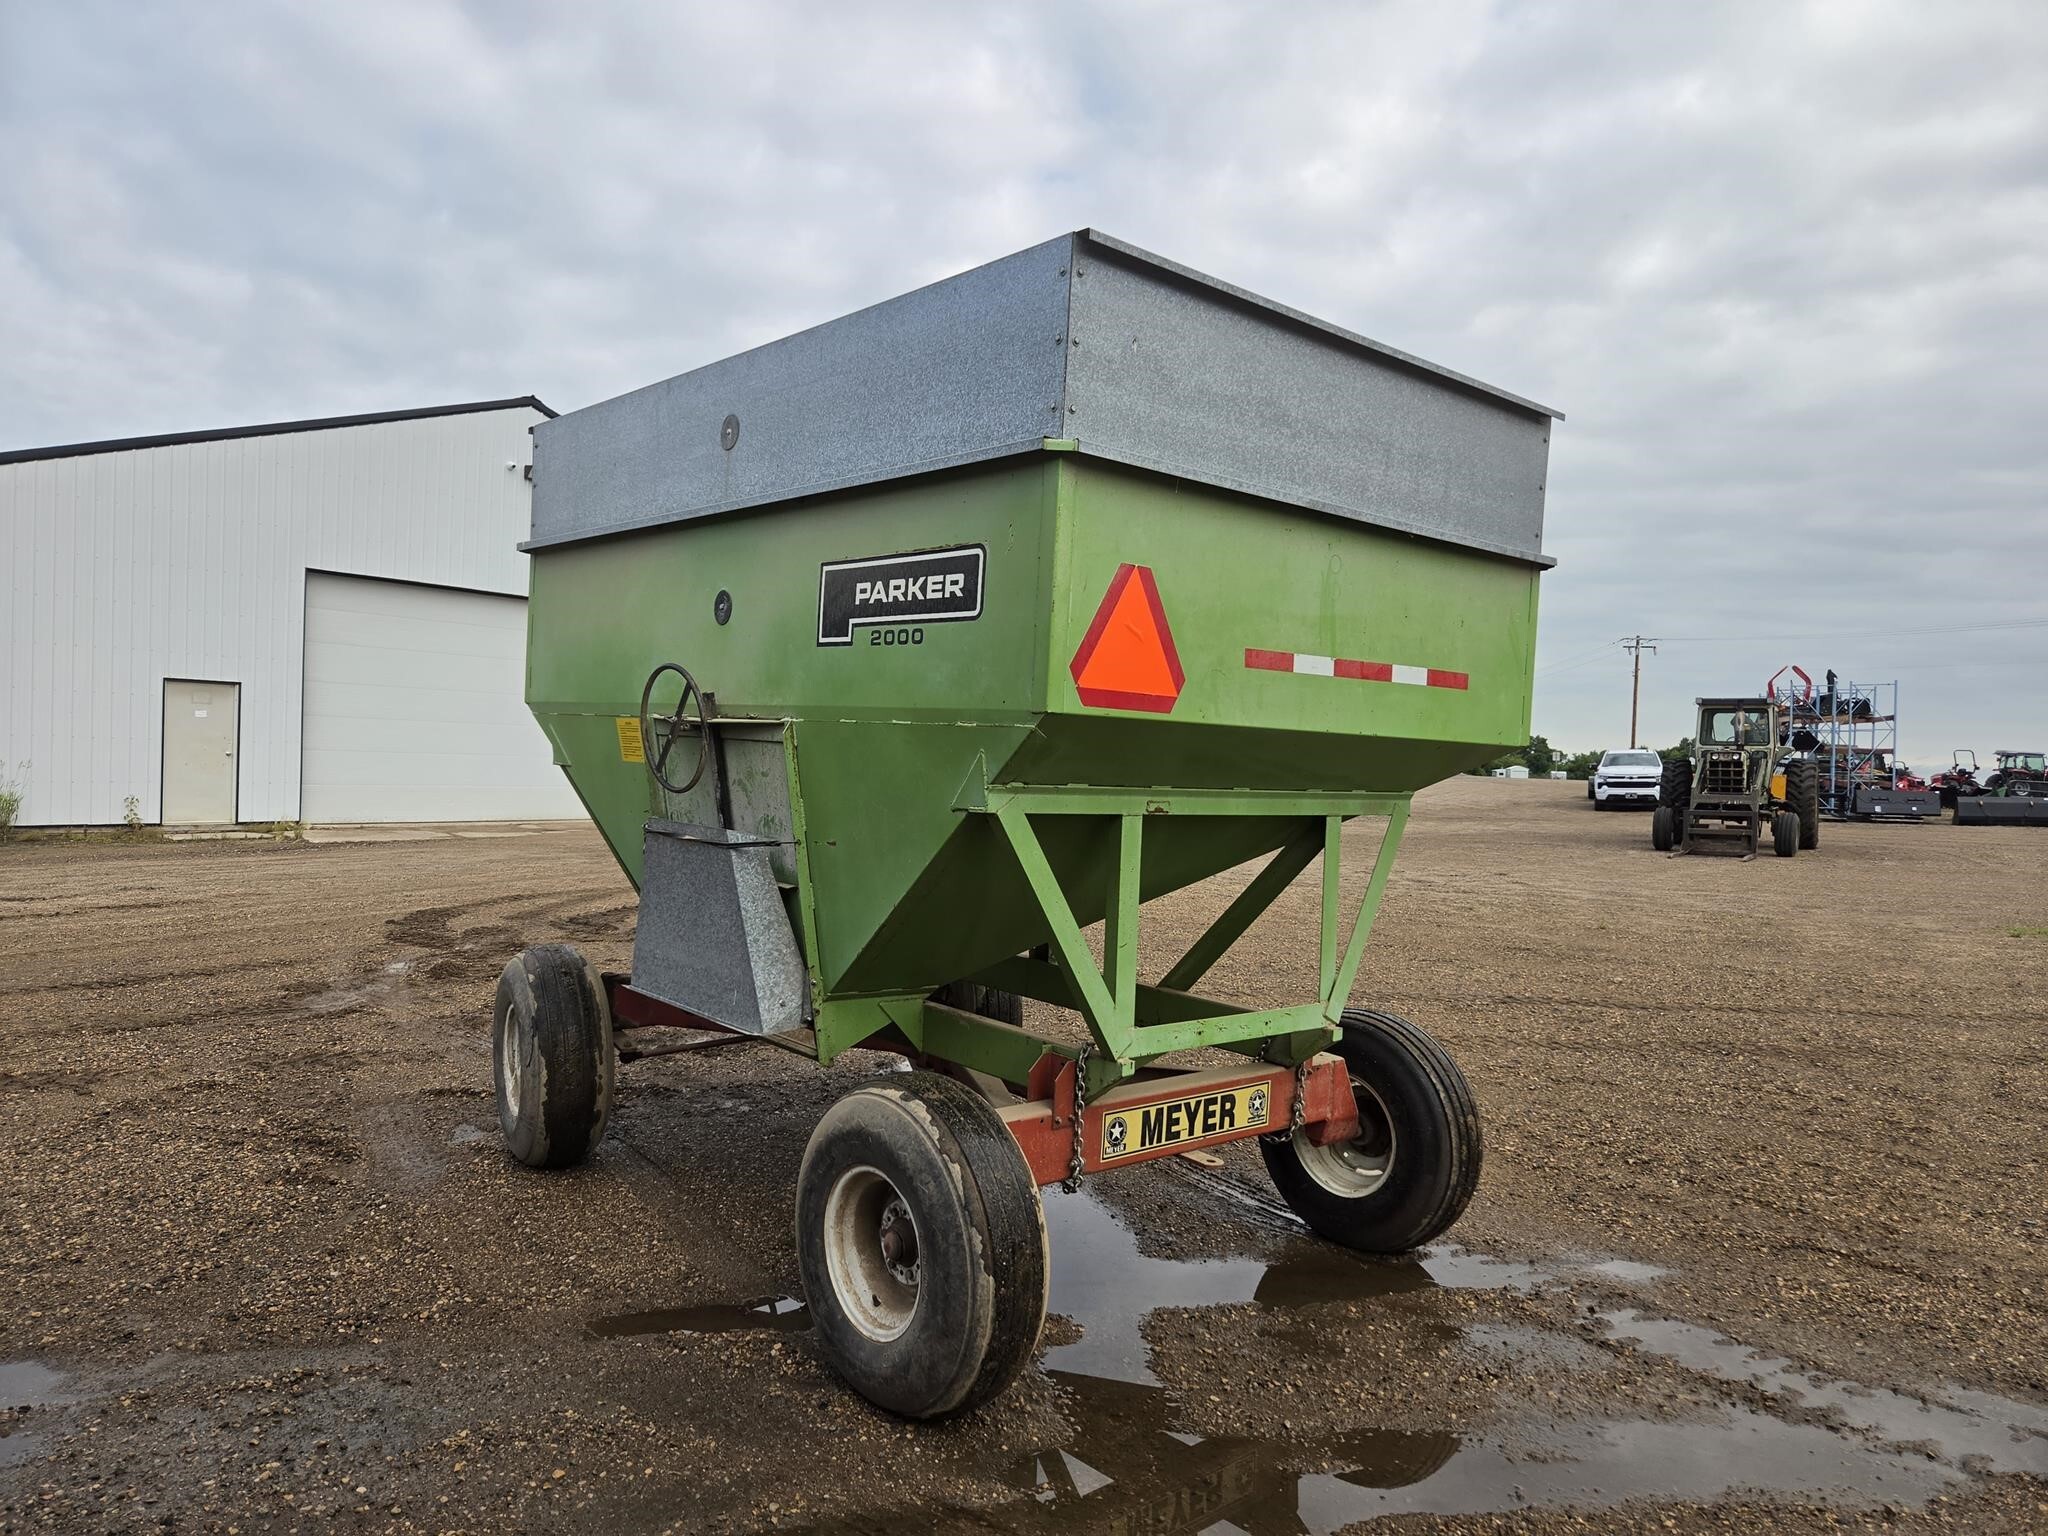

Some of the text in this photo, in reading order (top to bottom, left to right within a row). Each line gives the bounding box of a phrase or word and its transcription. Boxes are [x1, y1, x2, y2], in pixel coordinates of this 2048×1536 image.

[855, 573, 965, 605] PARKER
[870, 628, 924, 646] 2000
[1140, 1093, 1237, 1148] MEYER
